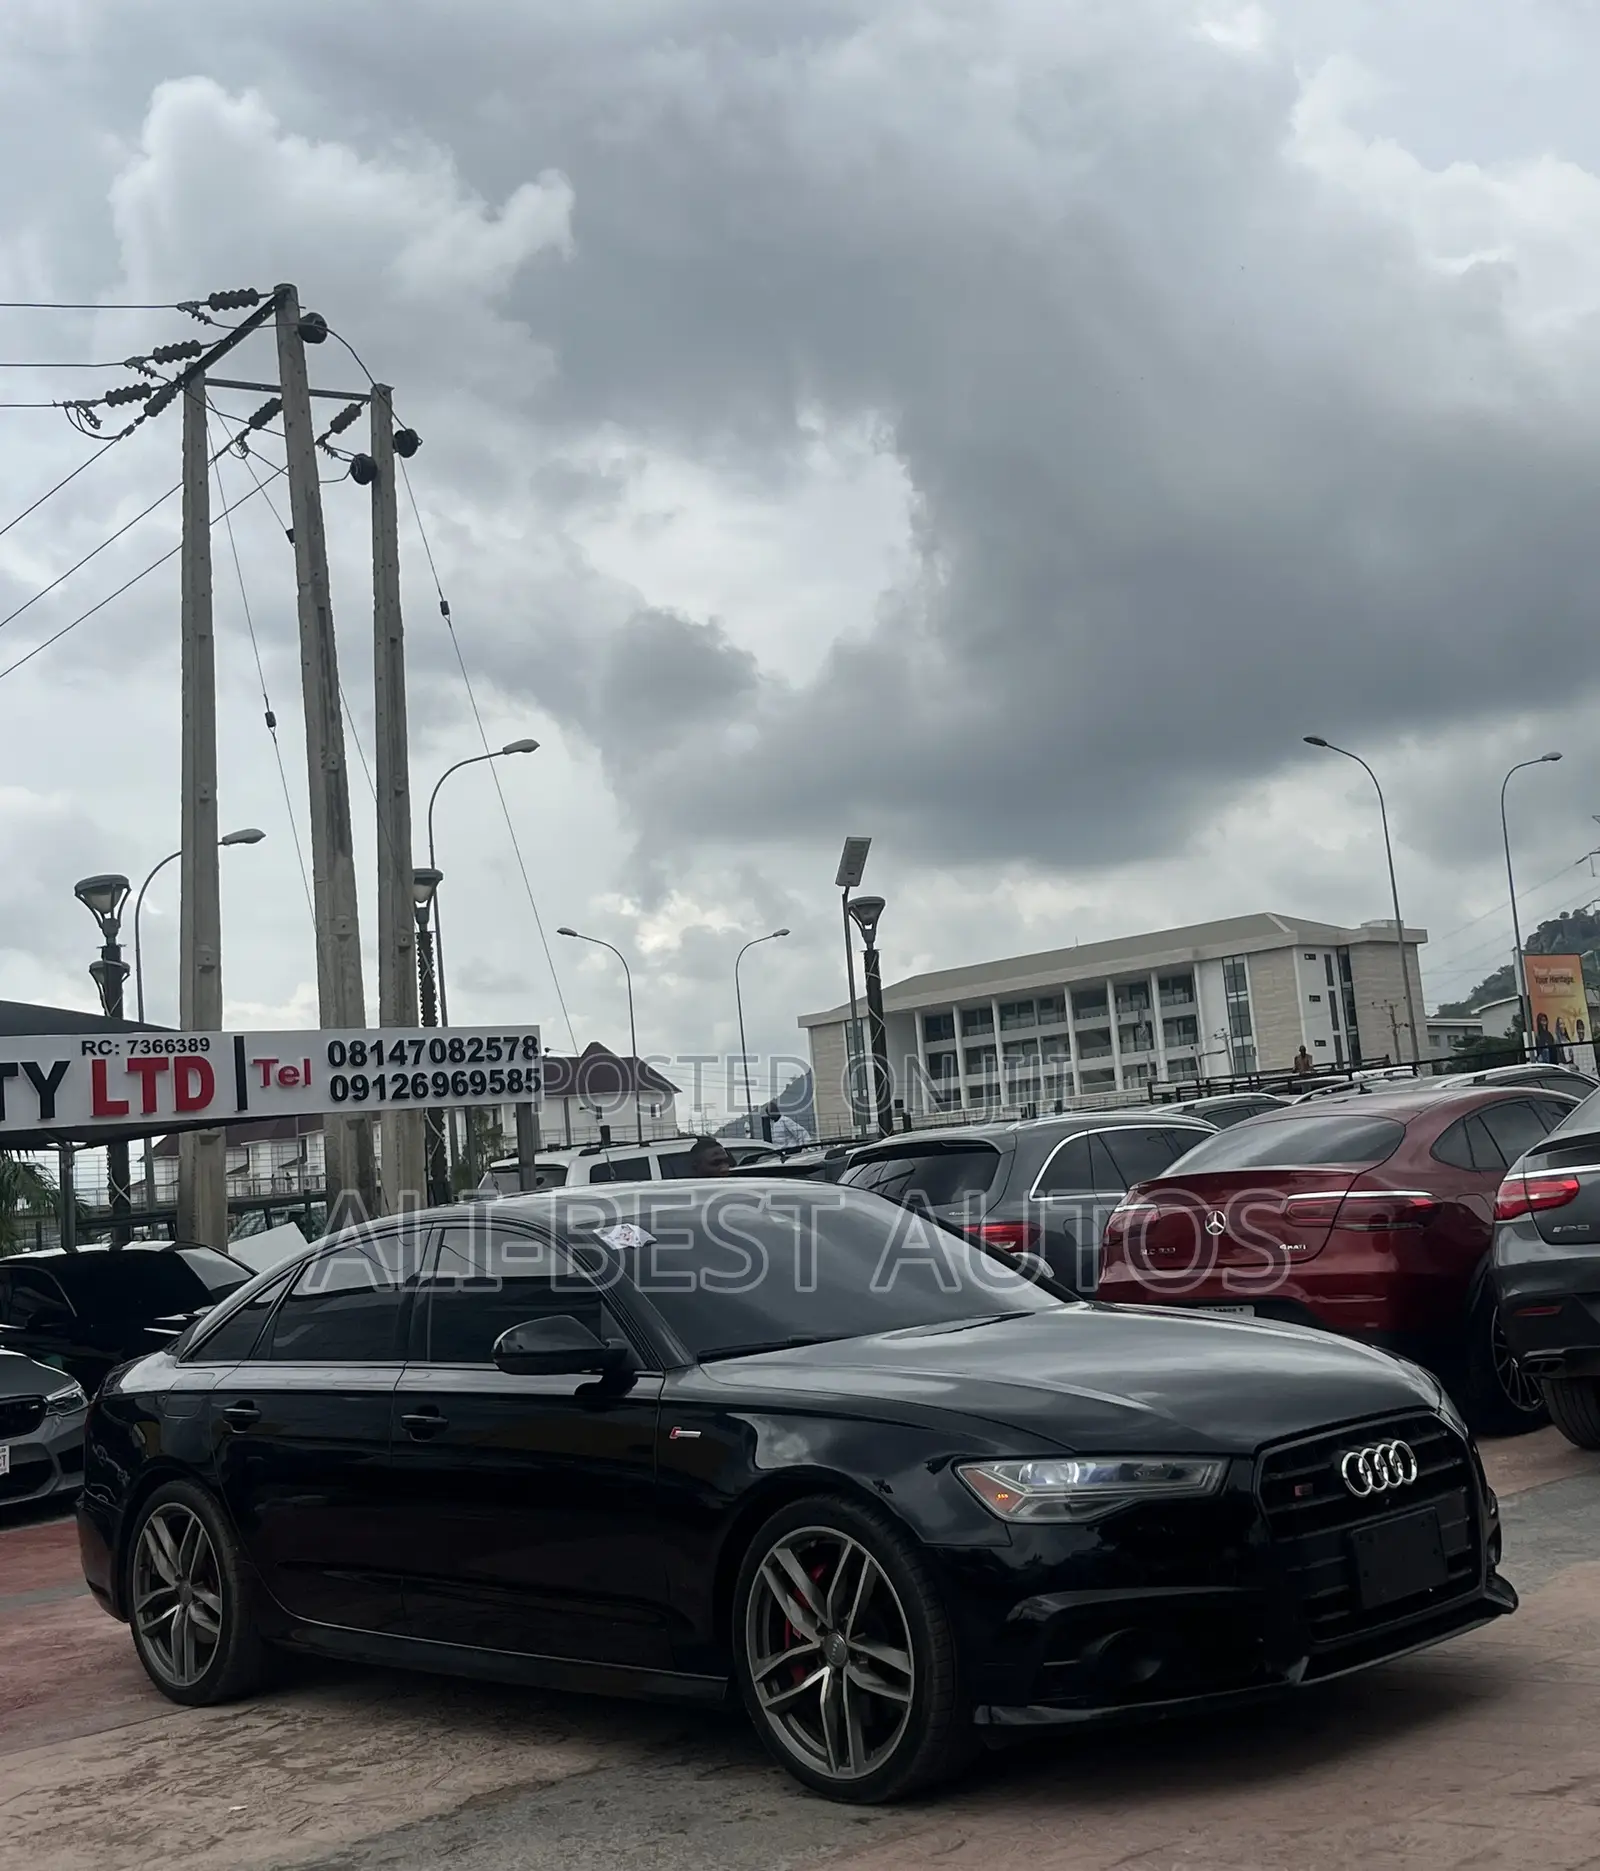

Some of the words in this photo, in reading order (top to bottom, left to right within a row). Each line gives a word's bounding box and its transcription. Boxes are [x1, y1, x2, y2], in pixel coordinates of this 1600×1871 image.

[81, 1039, 120, 1056] RC:
[127, 1037, 211, 1055] 7366389
[327, 1035, 539, 1068] 08147082578
[91, 1056, 215, 1117] LTD
[251, 1058, 312, 1088] Tel
[330, 1067, 542, 1102] 09126969585
